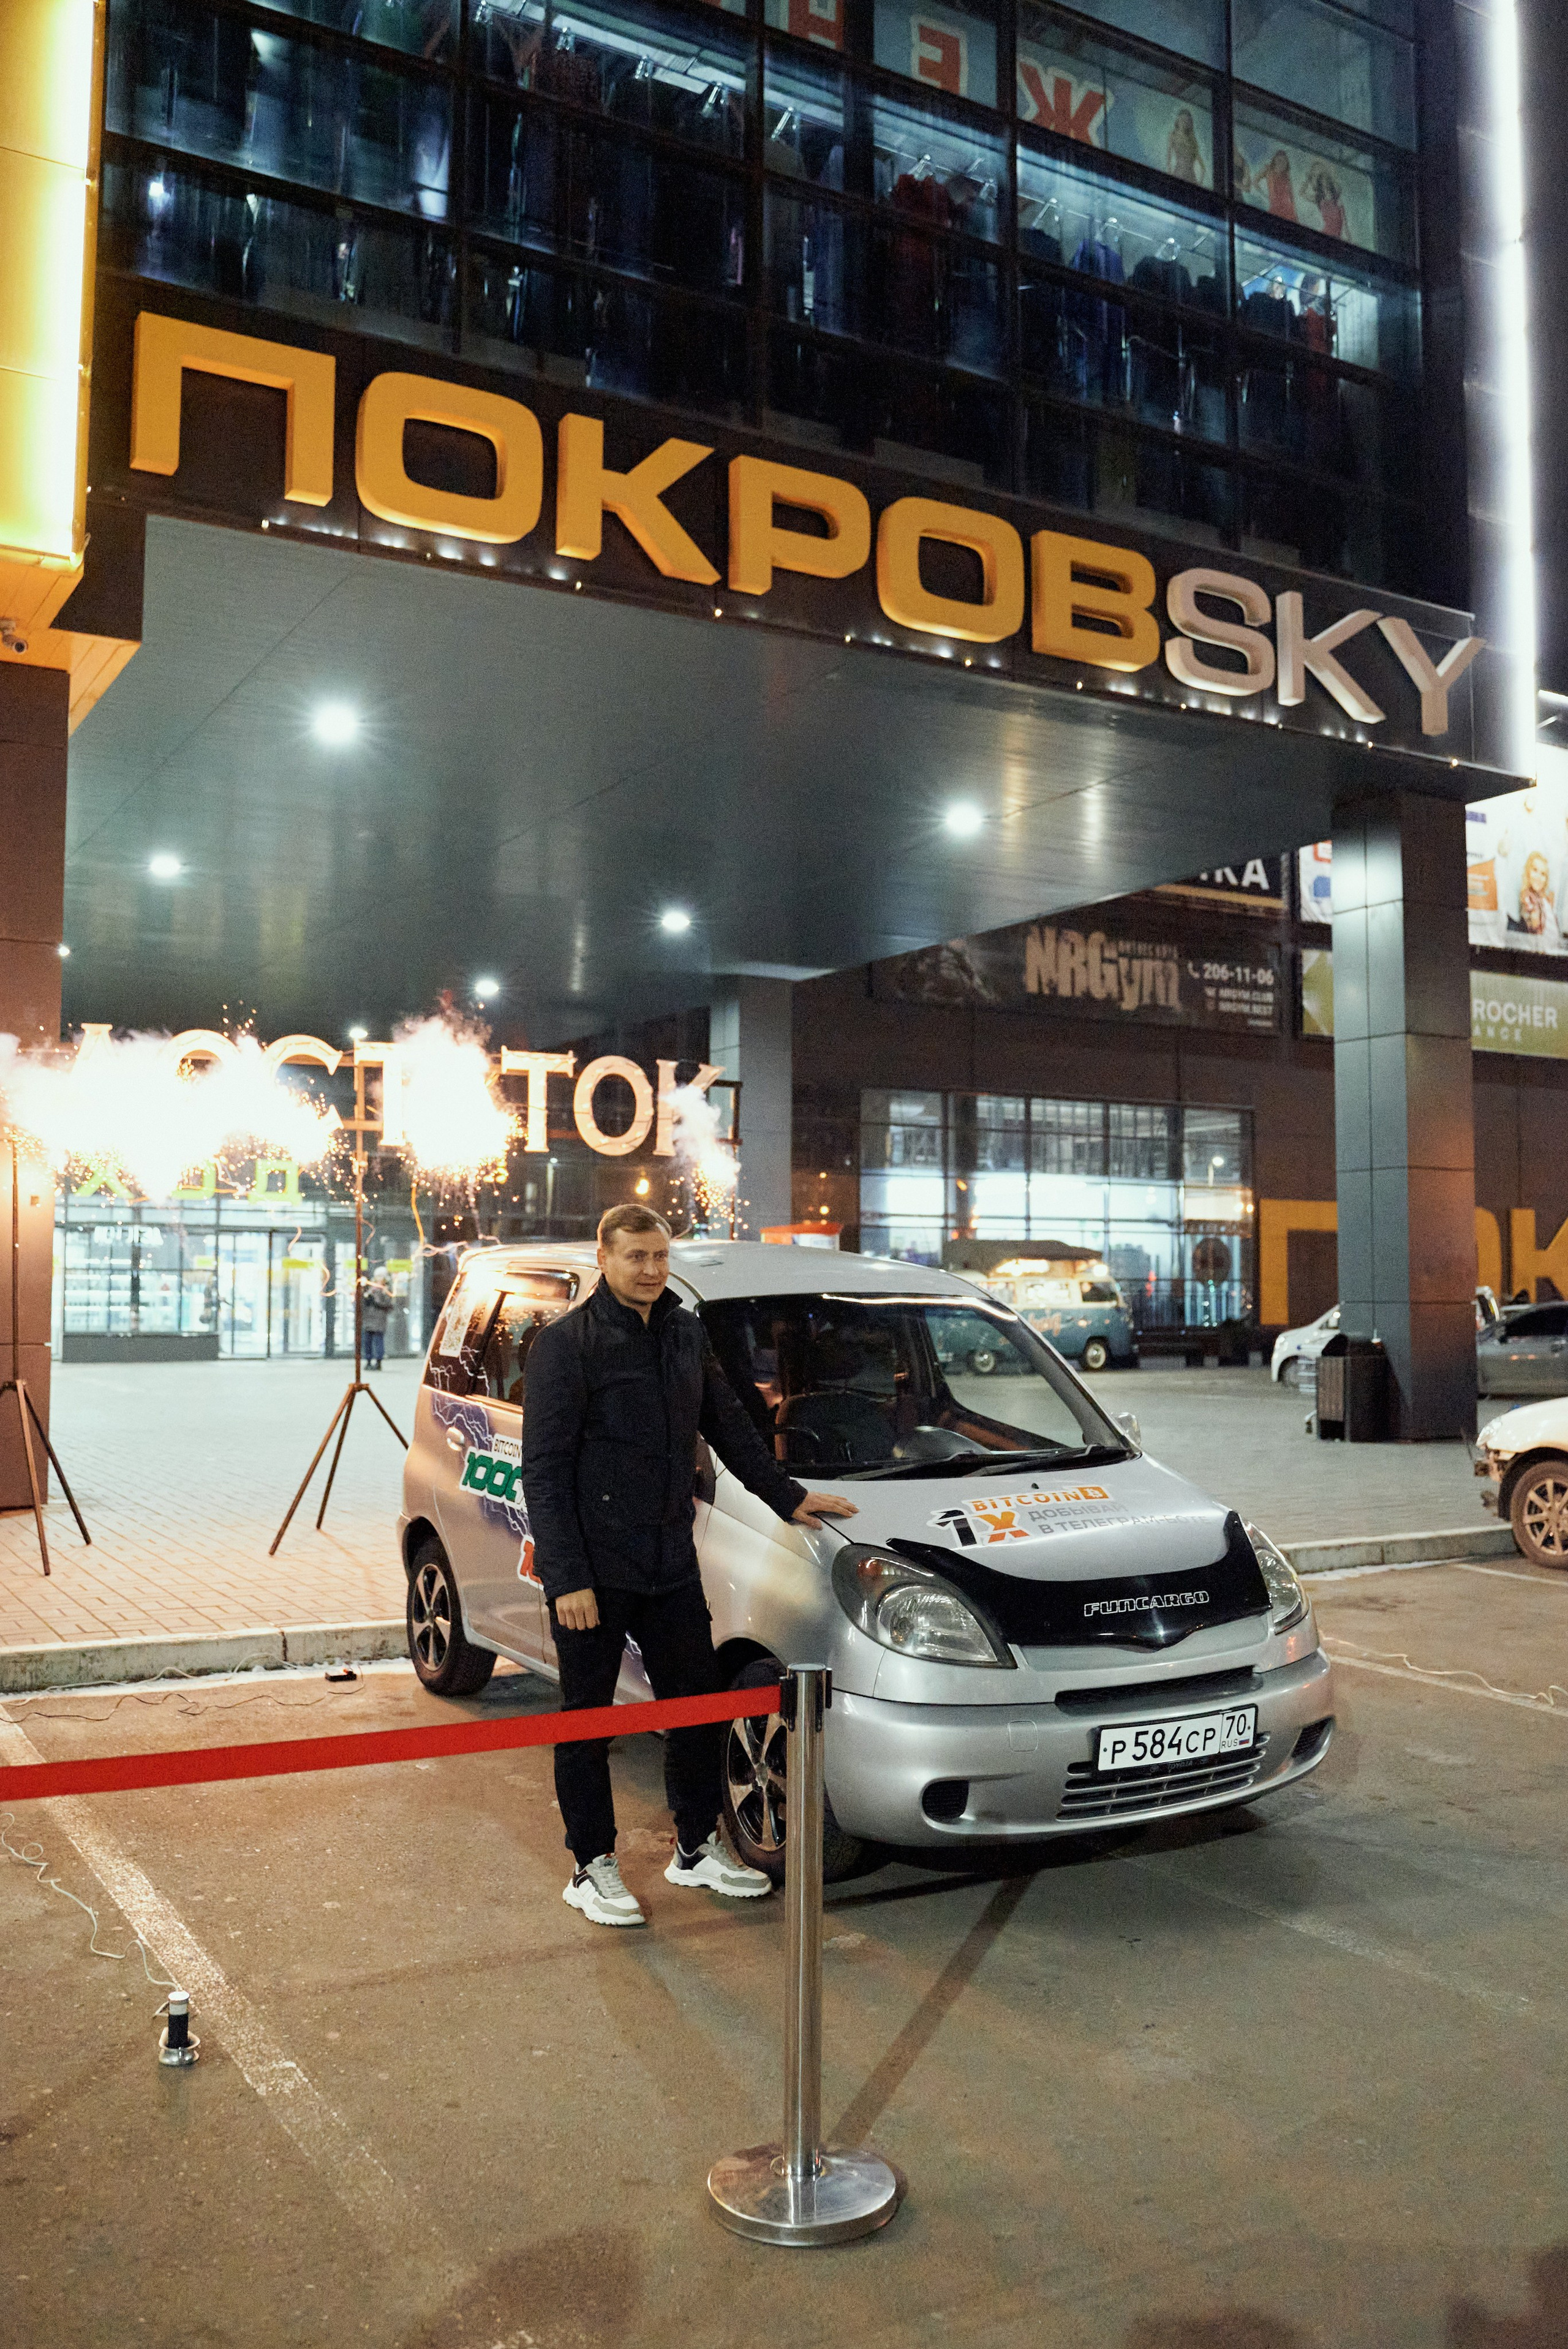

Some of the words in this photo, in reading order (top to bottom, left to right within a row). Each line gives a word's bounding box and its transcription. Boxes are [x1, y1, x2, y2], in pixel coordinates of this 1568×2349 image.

[1203, 962, 1274, 986] 206-11-06
[1472, 998, 1558, 1047] ROCHER
[971, 1490, 1082, 1512] BITCOIN
[1028, 1503, 1129, 1521] ДОБЫВАЙ
[935, 1509, 1030, 1547] 1X
[1038, 1523, 1054, 1534] В
[1054, 1514, 1212, 1532] ТЕЛЕГРАМ-БОТЕ
[1084, 1591, 1210, 1617] FUNCARGO
[1226, 1713, 1247, 1739] 70
[1221, 1738, 1238, 1749] RUS
